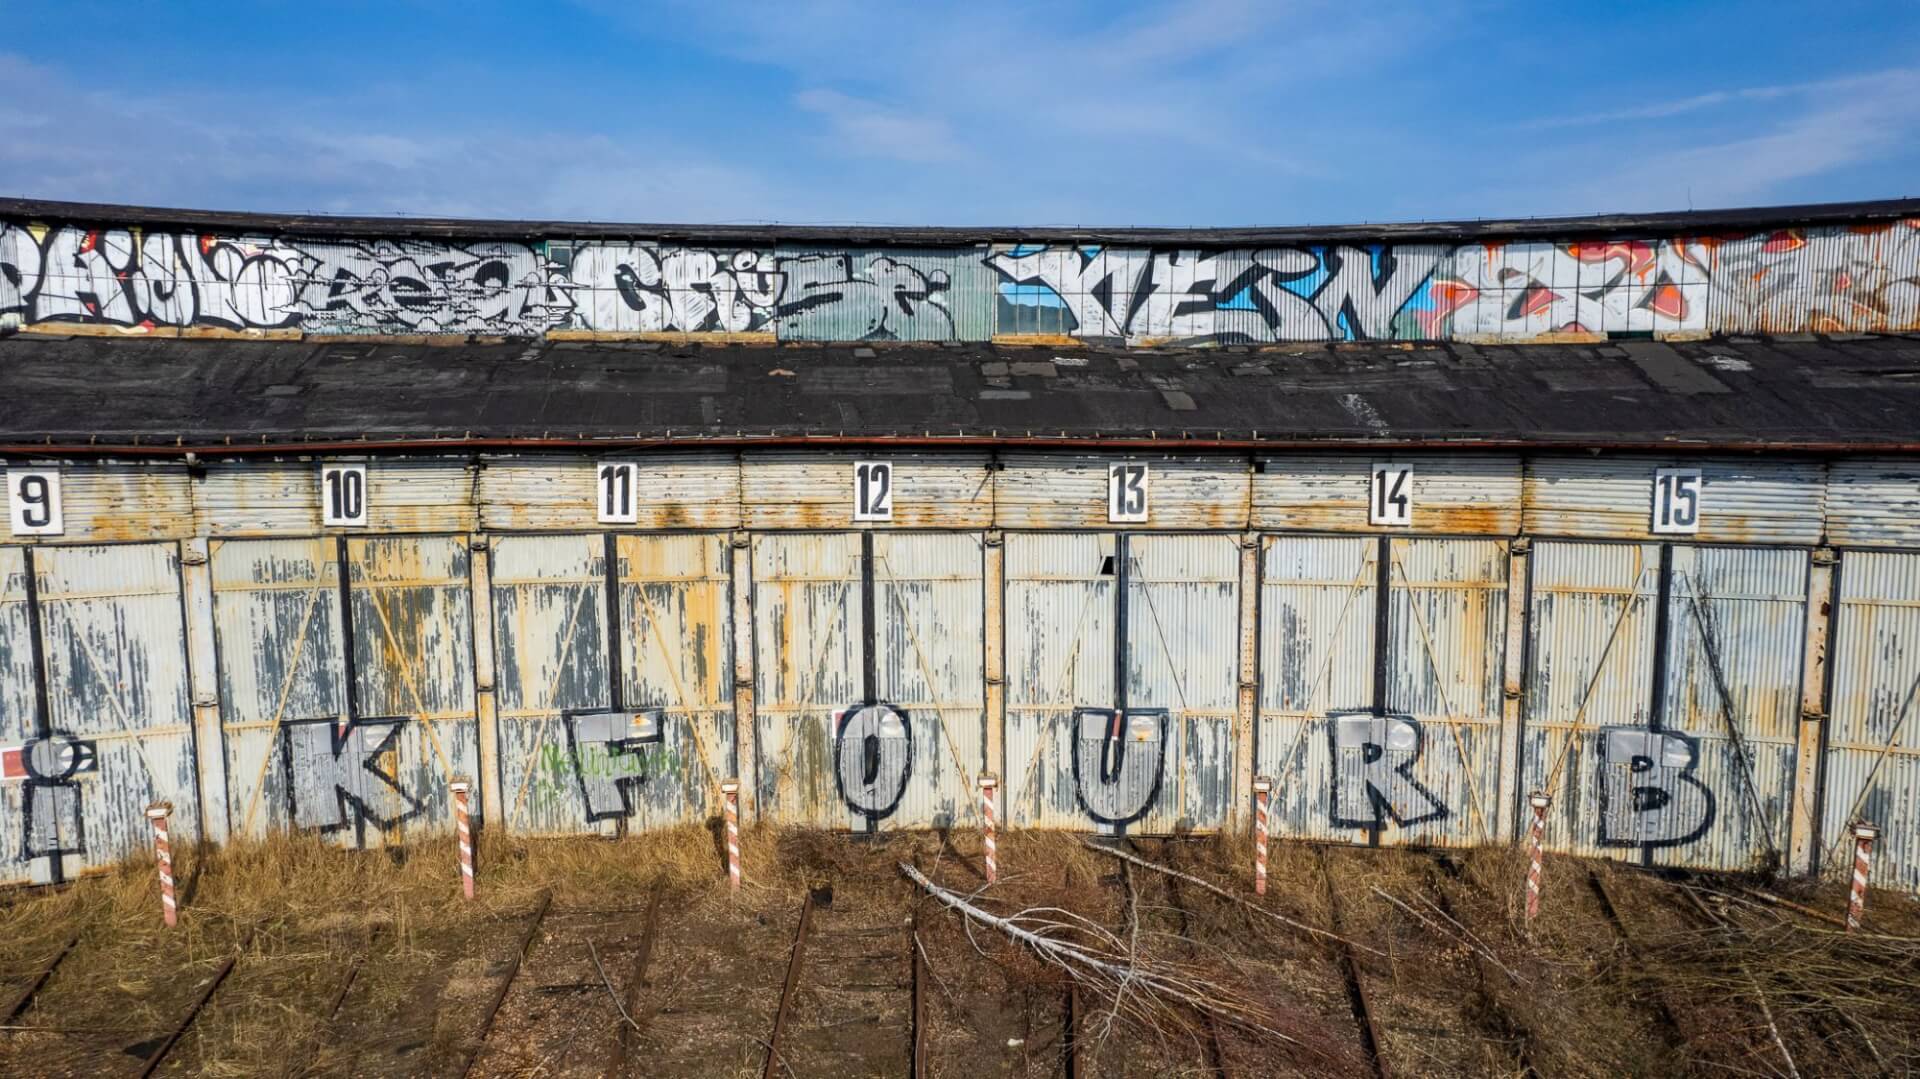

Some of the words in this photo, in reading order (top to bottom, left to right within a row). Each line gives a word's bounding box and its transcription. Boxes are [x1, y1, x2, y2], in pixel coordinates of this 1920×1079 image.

[20, 475, 50, 527] 9
[326, 470, 360, 518] 10
[601, 465, 629, 515] 11
[856, 464, 888, 514] 12
[1111, 465, 1144, 515] 13
[1376, 469, 1408, 518] 14
[1658, 475, 1696, 526] 15
